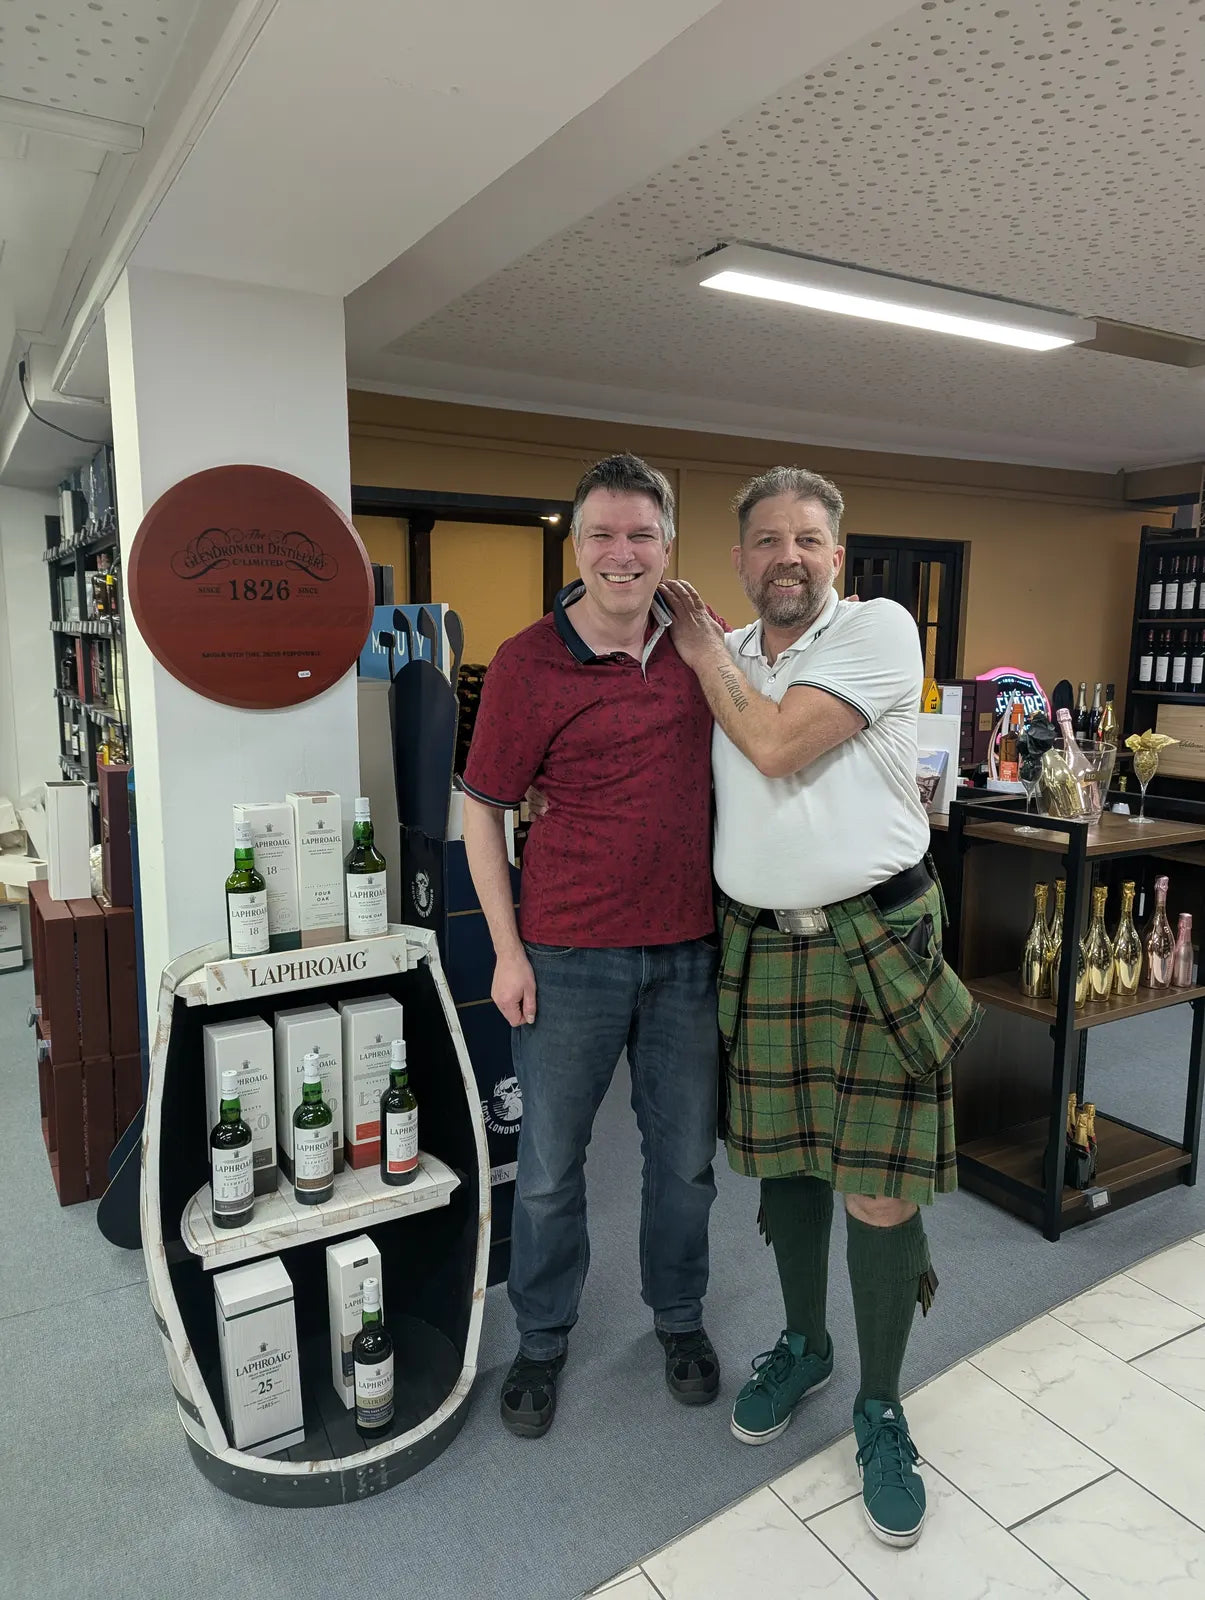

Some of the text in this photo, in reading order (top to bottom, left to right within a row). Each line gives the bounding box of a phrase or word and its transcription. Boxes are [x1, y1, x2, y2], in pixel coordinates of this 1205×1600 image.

[229, 579, 290, 600] 1826
[372, 630, 425, 657] MUY
[717, 664, 749, 713] LAPHROAIG
[253, 839, 291, 849] APHROAIG
[301, 835, 341, 845] LAPHROAIG
[266, 866, 278, 875] 18
[231, 906, 267, 918] LAPHROA
[249, 927, 259, 936] 18
[250, 951, 367, 988] LAPHROAIG
[359, 1048, 392, 1061] LAPHROA
[296, 1059, 337, 1073] LAOAIG
[237, 1073, 269, 1086] HROAIG
[488, 1121, 521, 1135] LOMOND
[296, 1139, 333, 1152] LAPHROA
[215, 1159, 252, 1173] LAPHROA
[235, 1350, 291, 1377] LAPHROAIG
[258, 1378, 273, 1395] 25
[358, 1374, 393, 1389] LAPHROA
